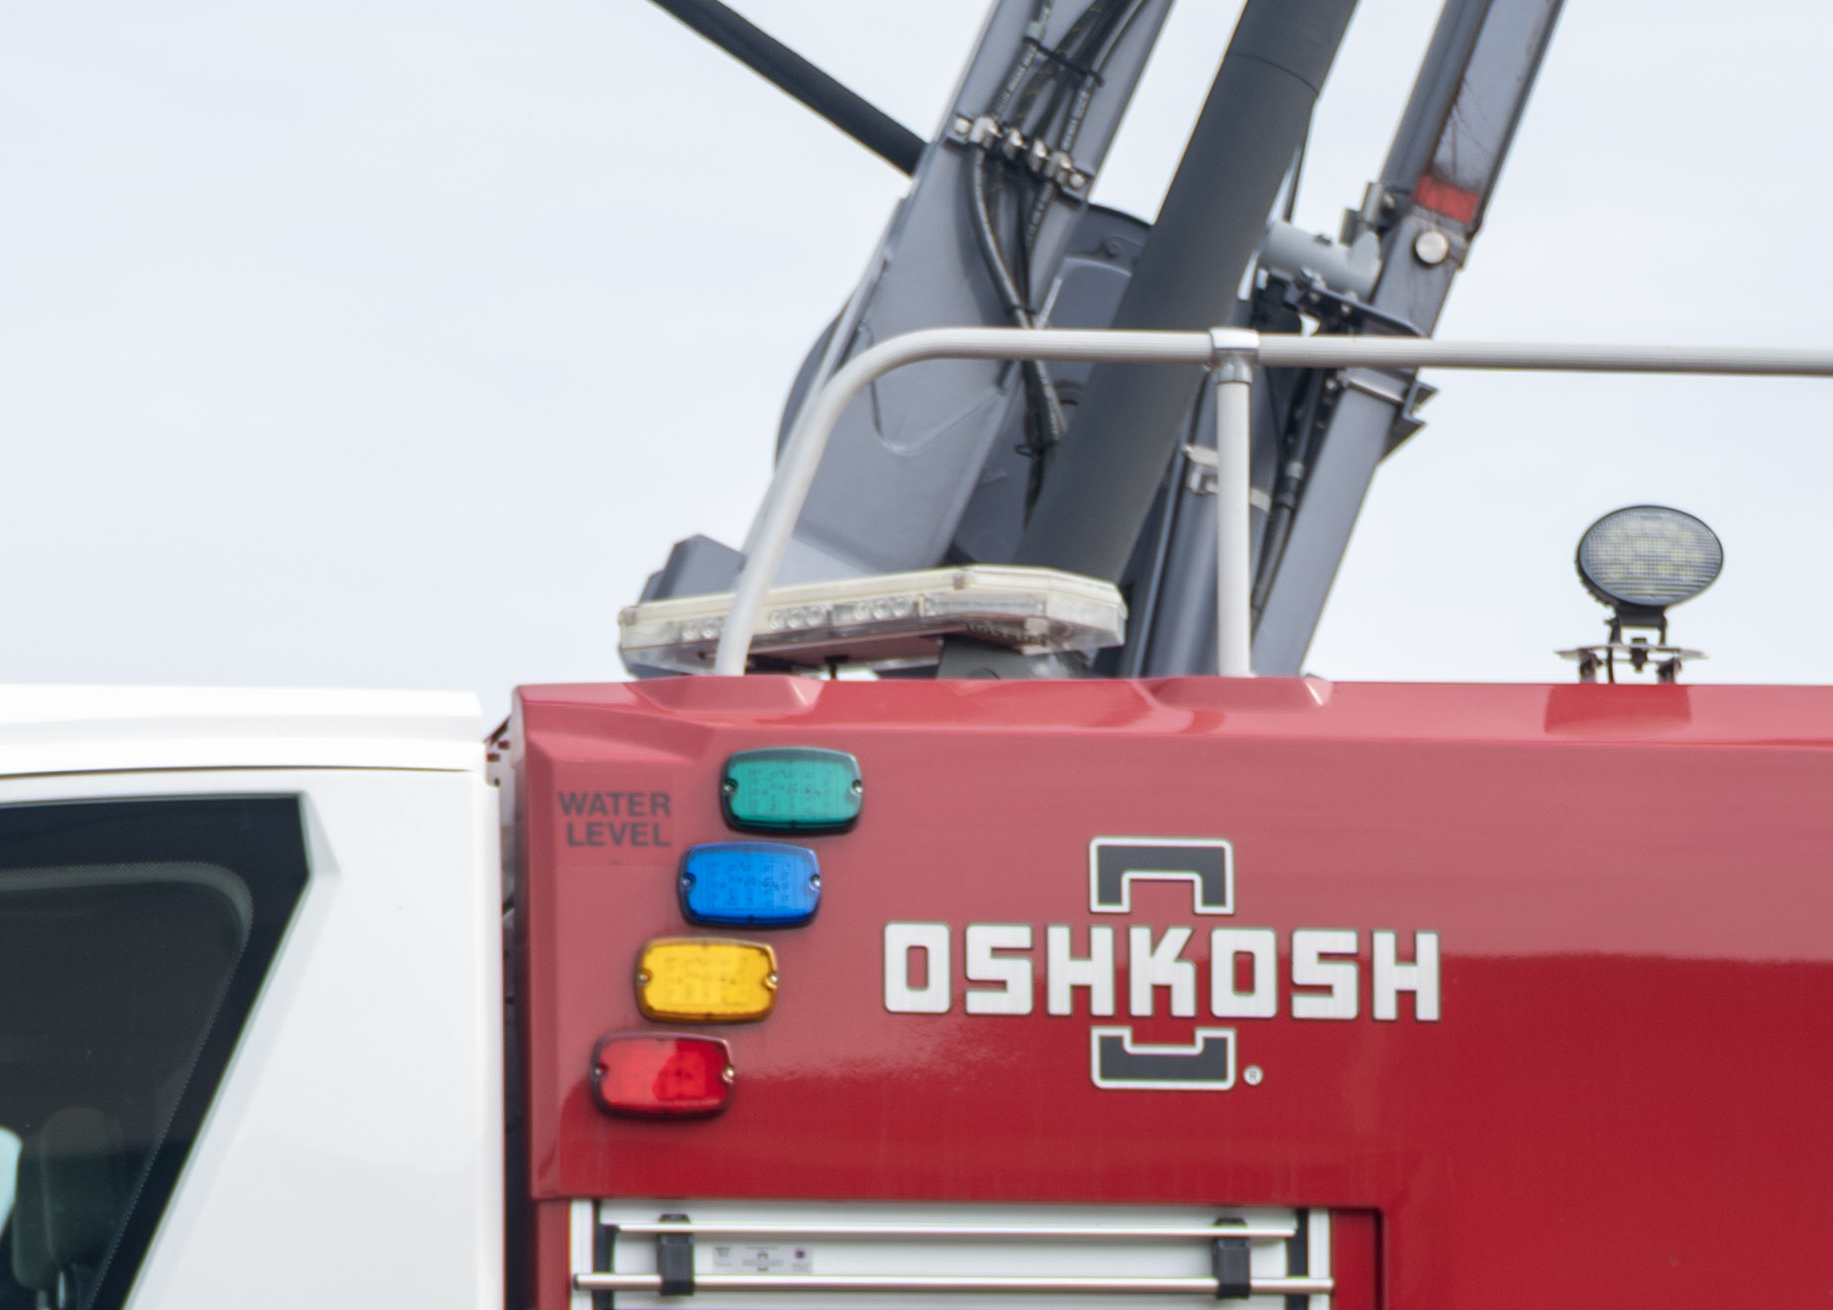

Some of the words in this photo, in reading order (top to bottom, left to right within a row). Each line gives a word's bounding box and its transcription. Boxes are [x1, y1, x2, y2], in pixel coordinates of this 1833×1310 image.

[558, 791, 671, 817] WATER
[567, 821, 671, 847] LEVEL
[884, 922, 1441, 1022] OSHKOSH
